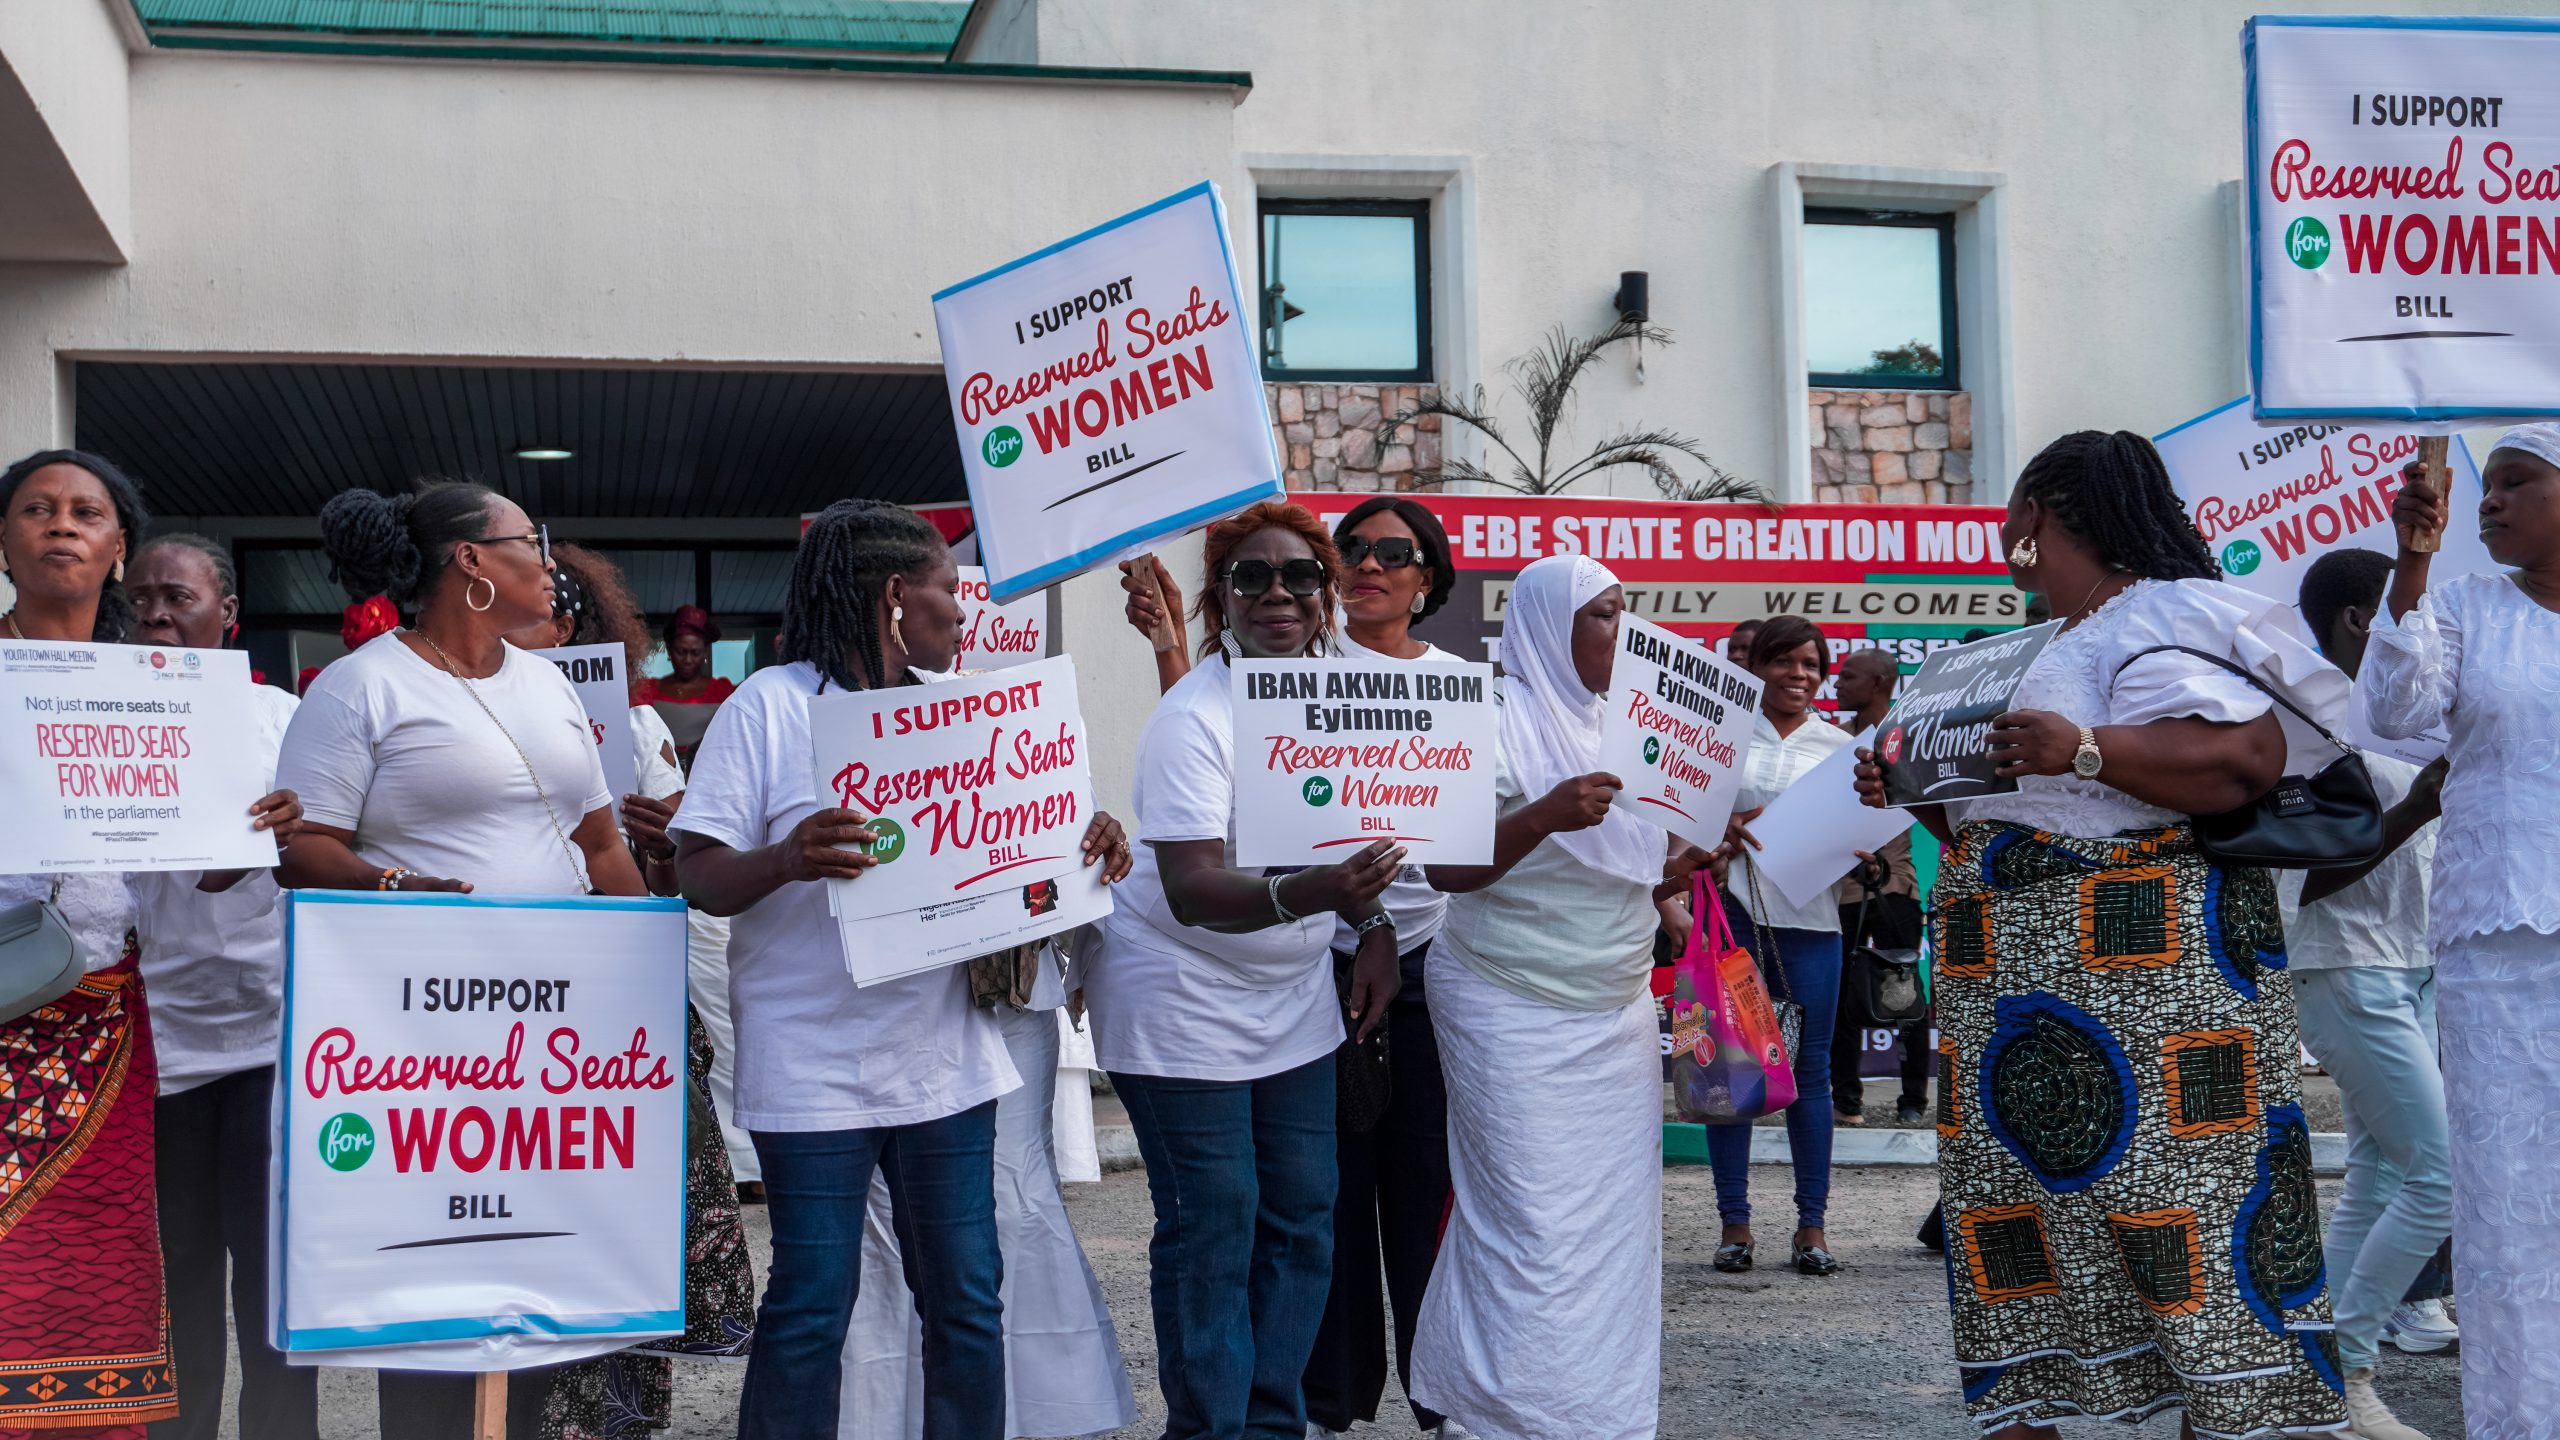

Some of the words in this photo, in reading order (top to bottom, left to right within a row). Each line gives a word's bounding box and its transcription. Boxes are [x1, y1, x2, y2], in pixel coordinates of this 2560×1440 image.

[2352, 95, 2360, 125] I
[2371, 94, 2503, 128] SUPPORT
[2270, 135, 2464, 203] Reserved
[2478, 141, 2560, 205] Sea
[2292, 216, 2329, 262] for
[2339, 213, 2560, 276] WOMEN
[1014, 320, 1026, 344] I
[1032, 275, 1135, 339] SUPPORT
[2395, 295, 2453, 318] BILL
[960, 318, 1117, 426] Reserved
[1126, 285, 1230, 359] Seats
[987, 433, 1021, 466] for
[1026, 344, 1215, 455] WOMEN
[1086, 442, 1135, 474] BILL
[2238, 451, 2250, 471] I
[2253, 425, 2345, 465] SUPPO
[2195, 444, 2343, 541] Reserved
[2347, 433, 2419, 477] Sea
[1553, 515, 1682, 560] STATE
[1693, 517, 1905, 562] CREATION
[2226, 544, 2259, 573] for
[2260, 471, 2407, 562] WOME
[1765, 591, 2018, 615] WELCOMES
[983, 616, 1039, 653] Seats
[3, 649, 28, 661] YOUTH
[29, 649, 50, 661] TOWN
[51, 650, 68, 661] HALL
[69, 651, 97, 662] MEETING
[554, 656, 613, 683] BOM
[1626, 627, 1671, 668] IBAN
[1672, 649, 1720, 692] AKWA
[1720, 678, 1758, 714] IBOM
[1938, 657, 1949, 675] I
[1946, 637, 2034, 673] SUPPORT
[25, 697, 55, 712] Not
[56, 697, 84, 716] just
[86, 700, 123, 713] more
[127, 700, 166, 714] seats
[169, 700, 192, 714] but
[1247, 672, 1318, 700] IBAN
[1325, 672, 1410, 700] AKWA
[1416, 674, 1483, 703] IBOM
[1656, 671, 1725, 726] Eyimme
[1888, 667, 1986, 724] Reserved
[1966, 666, 2022, 708] Seats
[872, 712, 883, 739] I
[894, 680, 1043, 736] SUPPORT
[1305, 703, 1433, 733] Eyimme
[1627, 688, 1701, 747] Reserved
[1697, 726, 1737, 769] Seats
[36, 723, 136, 758] RESERVED
[138, 725, 191, 759] SEATS
[1264, 735, 1400, 774] Reserved
[1400, 735, 1473, 772] Seats
[1886, 732, 1899, 760] for
[1908, 712, 1994, 763] Women
[58, 763, 99, 797] FOR
[101, 764, 180, 798] WOMEN
[832, 727, 1003, 815] Reserved
[1006, 721, 1075, 780] Seats
[1646, 740, 1659, 756] for
[1659, 743, 1712, 793] Women
[1938, 762, 1960, 778] BILL
[1306, 782, 1329, 802] for
[1341, 772, 1439, 809] Women
[1664, 784, 1681, 804] BILL
[64, 805, 77, 820] in
[80, 805, 104, 820] the
[107, 805, 181, 822] parliament
[870, 825, 897, 856] for
[912, 791, 1076, 855] Women
[1361, 817, 1396, 831] BILL
[988, 843, 1028, 866] BILL
[920, 912, 937, 922] Her
[402, 977, 411, 1011] I
[424, 978, 570, 1013] SUPPORT
[305, 1020, 525, 1100] Reserved
[540, 1026, 675, 1095] Seats
[326, 1116, 373, 1165] for
[386, 1106, 636, 1173] WOMEN
[448, 1194, 513, 1220] BILL
